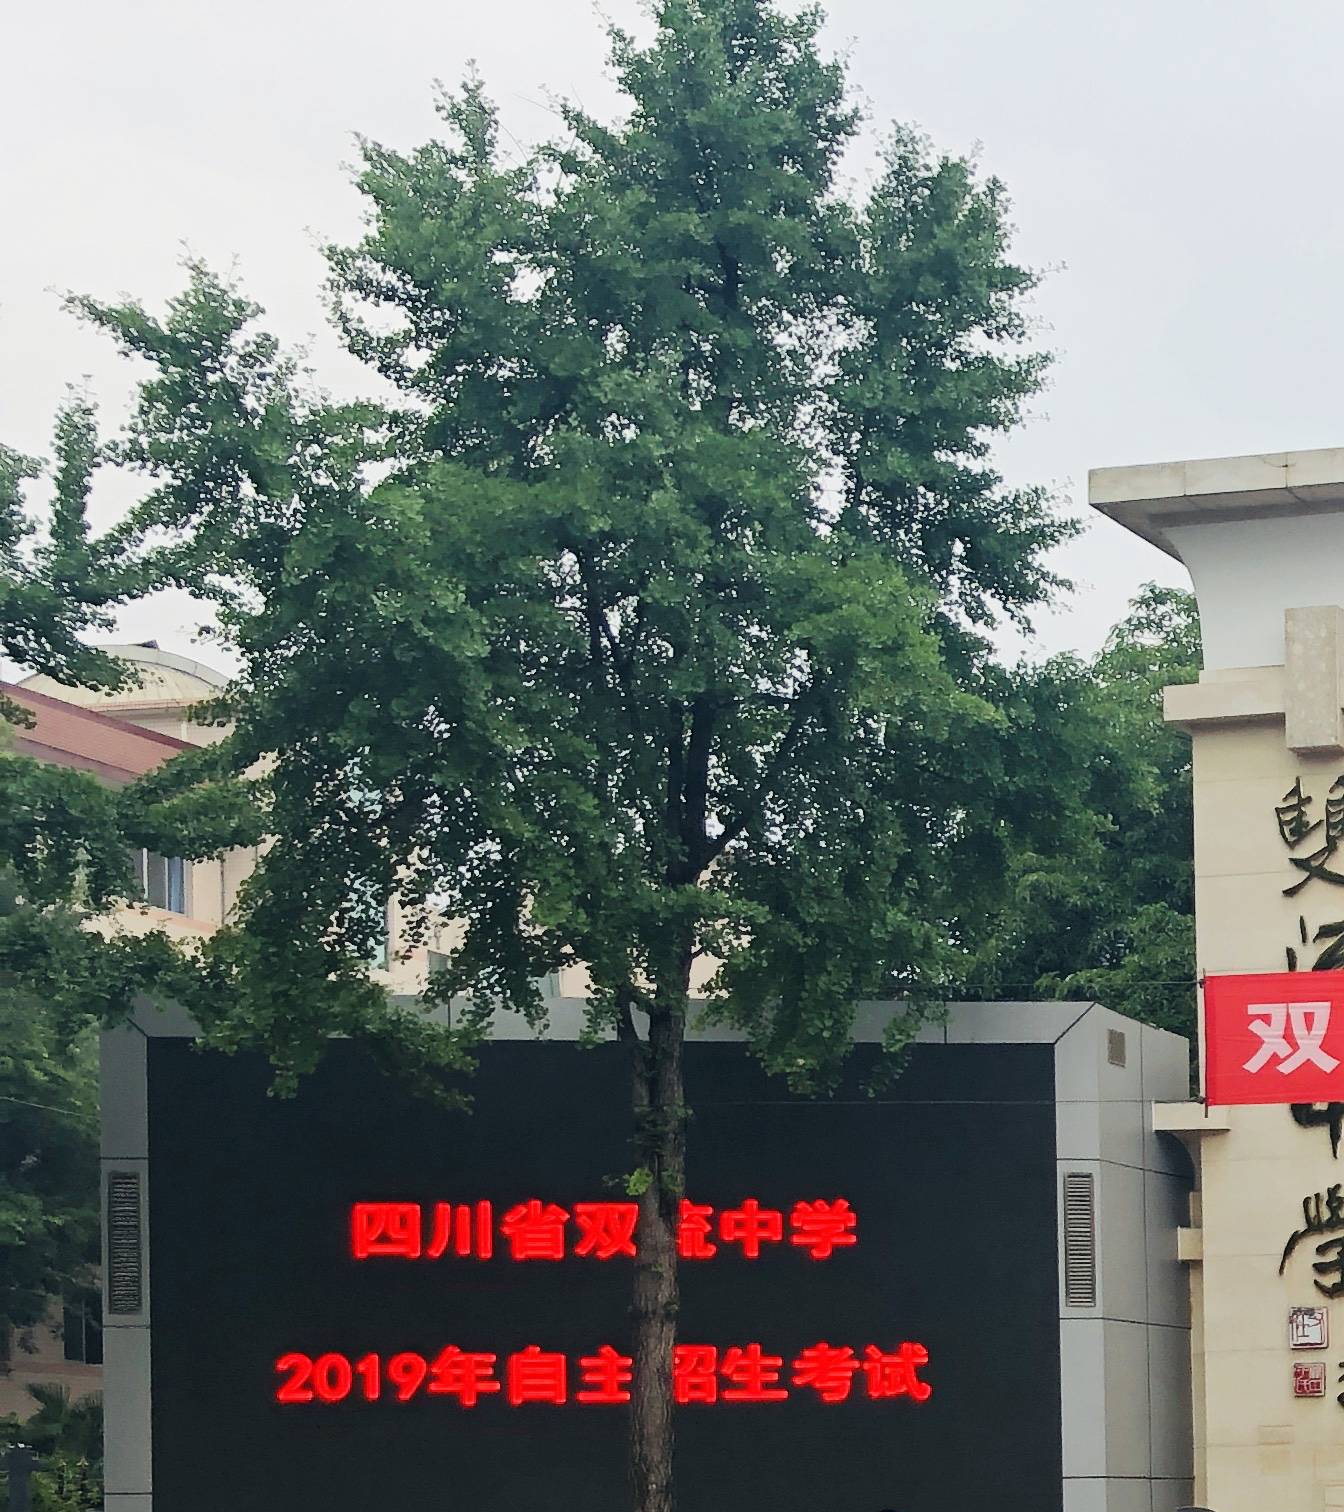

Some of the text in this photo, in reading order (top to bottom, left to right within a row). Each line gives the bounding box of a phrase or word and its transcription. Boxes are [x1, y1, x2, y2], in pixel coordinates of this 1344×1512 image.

[275, 1342, 934, 1406] 2019年自主招生考试
